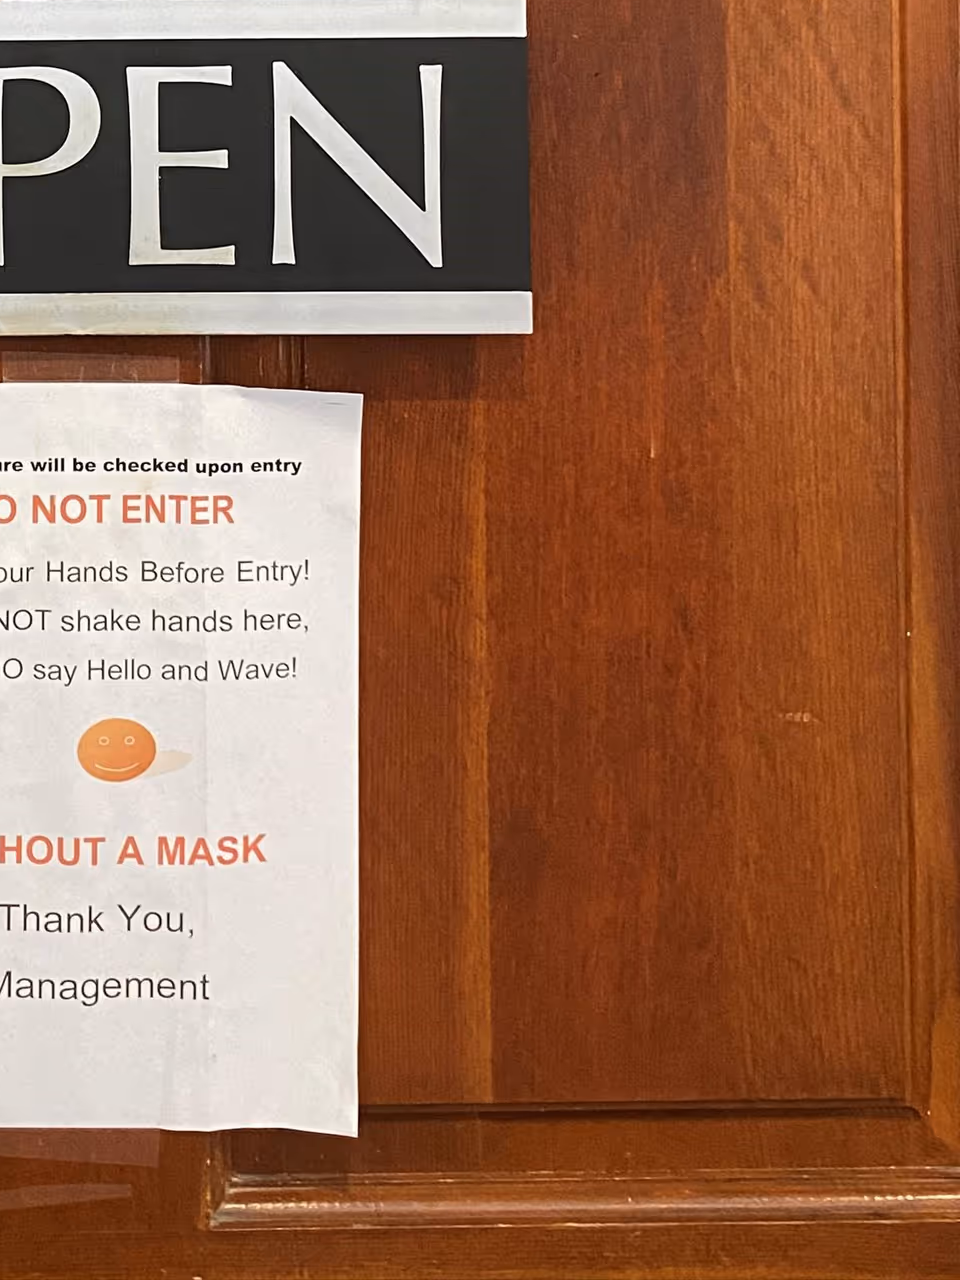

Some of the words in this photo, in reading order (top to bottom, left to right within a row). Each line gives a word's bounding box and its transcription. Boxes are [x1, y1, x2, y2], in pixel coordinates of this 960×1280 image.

[31, 458, 64, 472] will
[73, 458, 96, 472] be
[104, 458, 188, 472] checked
[196, 463, 243, 476] upon
[251, 459, 301, 475] entry
[32, 494, 111, 524] NOT
[123, 495, 234, 524] ENTER
[47, 561, 127, 582] Hands
[142, 561, 224, 583] Before
[238, 559, 308, 586] Entry!
[61, 609, 140, 632] shake
[153, 609, 232, 632] hands
[244, 609, 308, 631] here,
[34, 664, 77, 686] say
[88, 659, 151, 680] Hello
[162, 661, 207, 681] and
[218, 657, 296, 680] Wave!
[117, 836, 144, 865] A
[158, 834, 266, 866] MASK
[118, 905, 193, 937] You,
